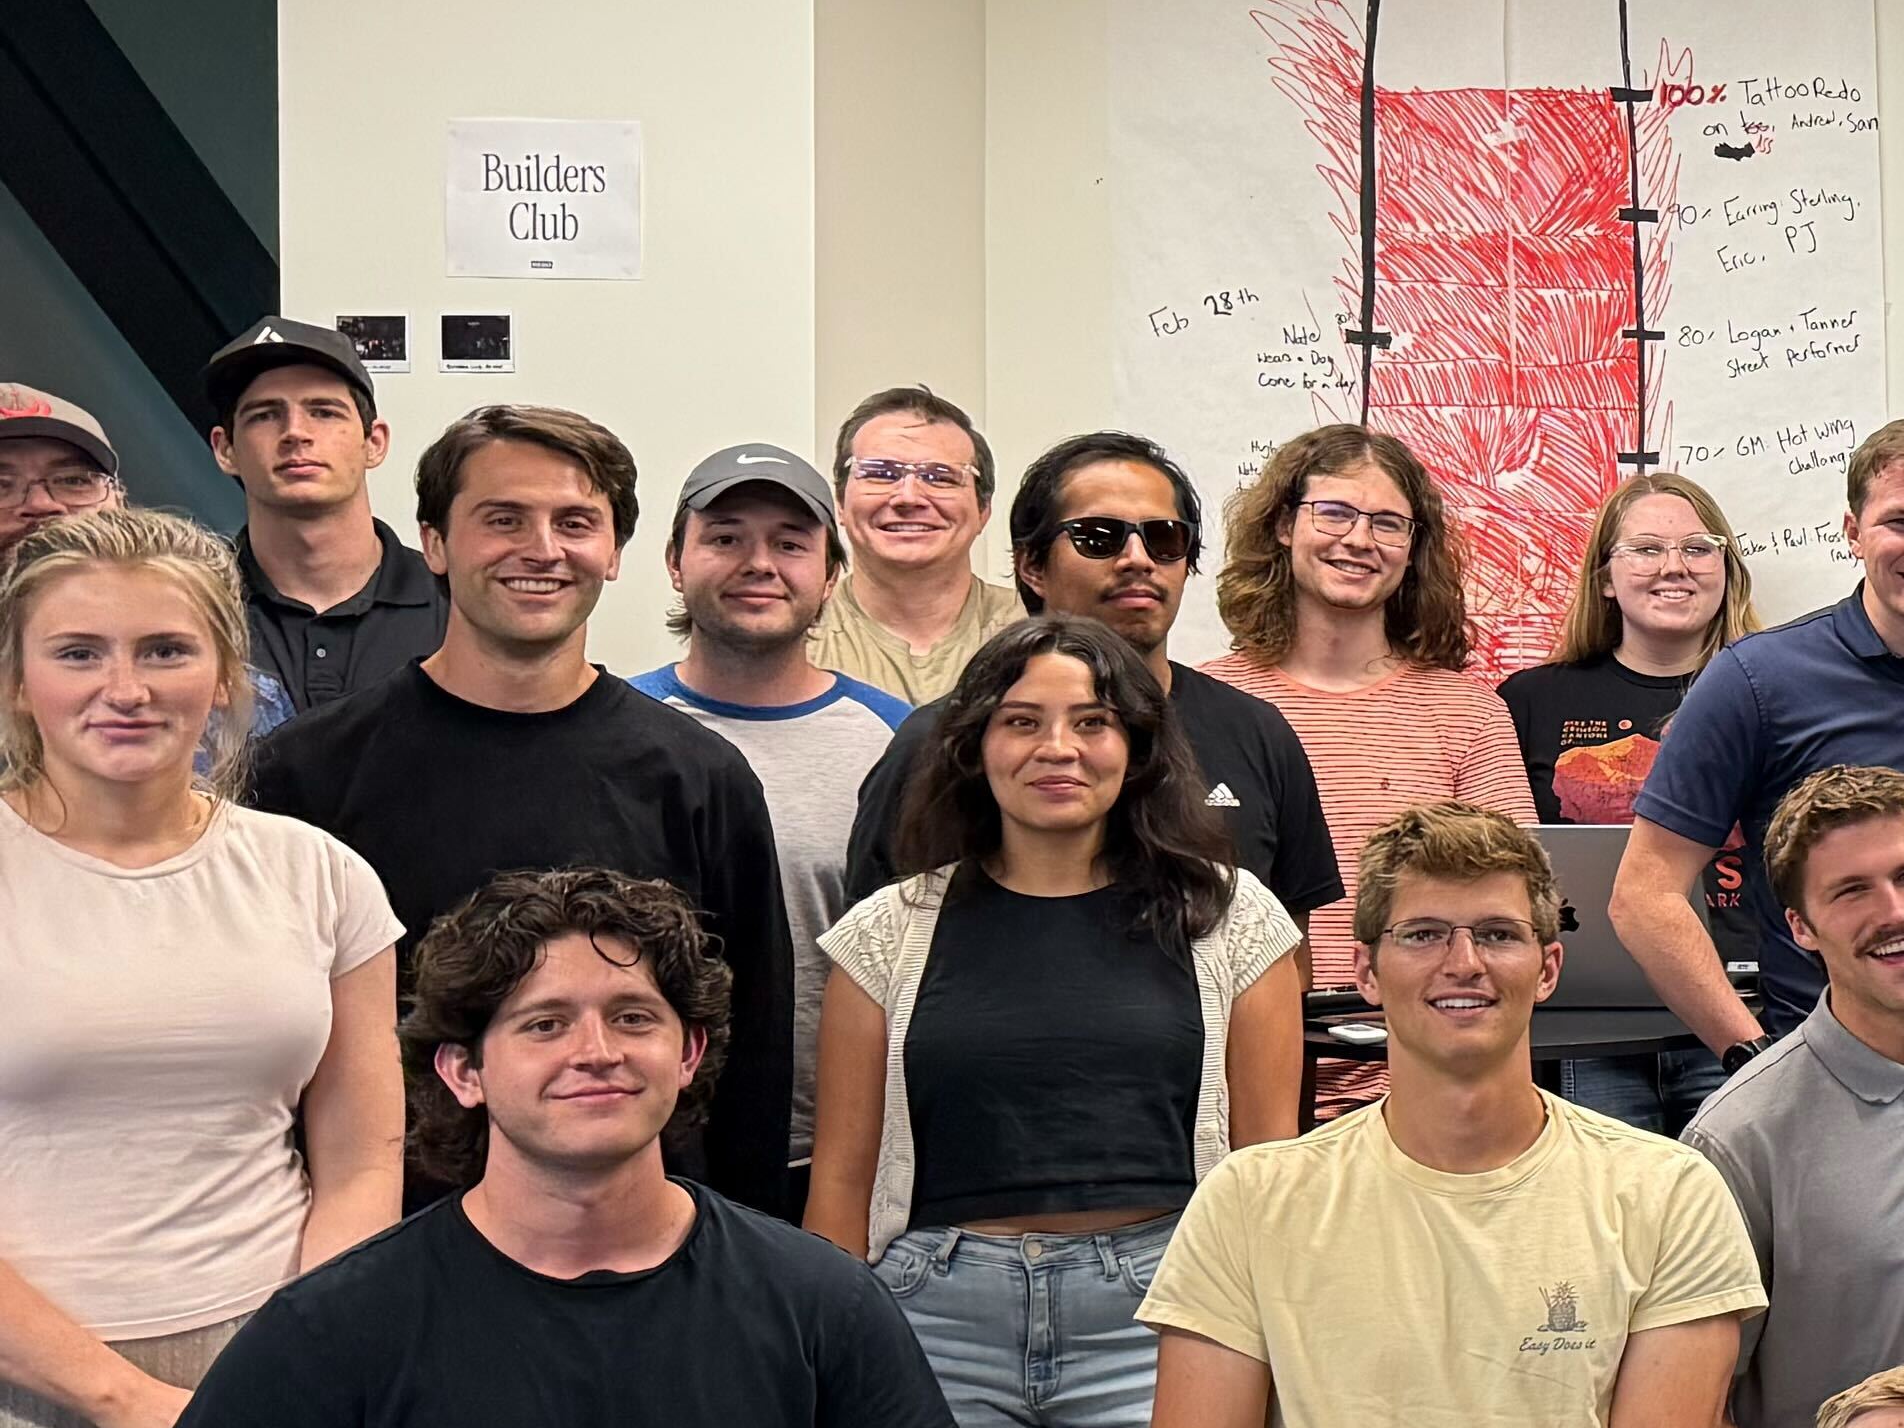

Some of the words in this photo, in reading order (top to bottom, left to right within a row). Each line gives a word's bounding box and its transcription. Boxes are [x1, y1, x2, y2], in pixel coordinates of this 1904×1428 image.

[1703, 122, 1729, 136] on
[482, 153, 606, 193] Builders
[509, 202, 579, 241] Club
[1148, 305, 1189, 337] Feb
[1727, 319, 1782, 351] Logan
[1519, 1337, 1550, 1356] Easy
[1553, 1337, 1583, 1352] Does
[1585, 1338, 1597, 1350] it
